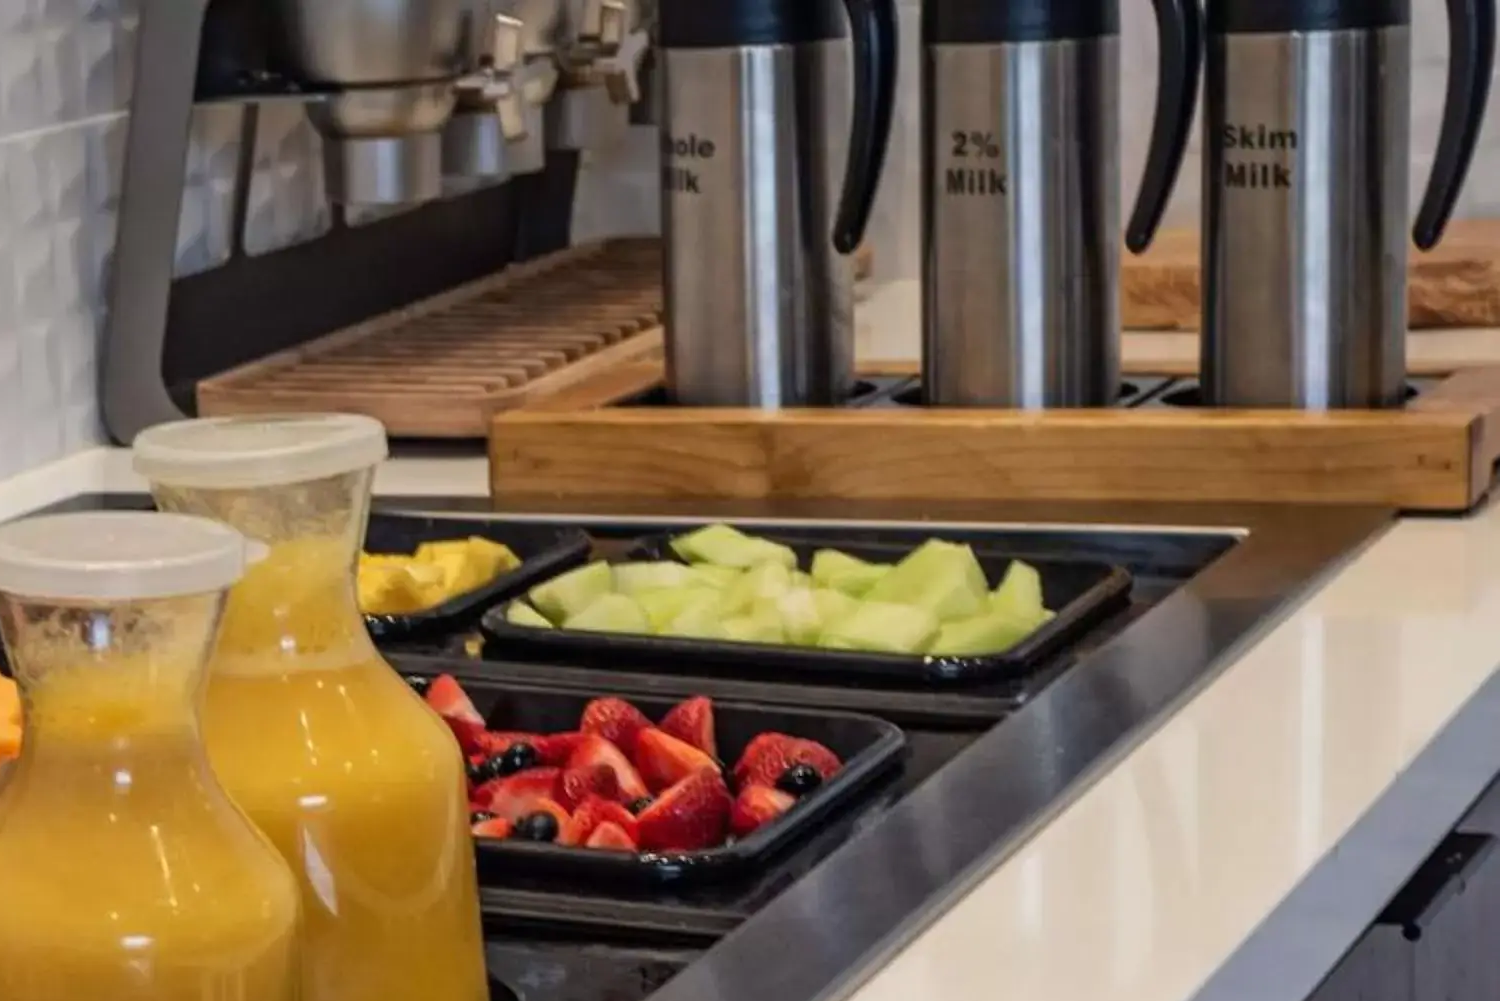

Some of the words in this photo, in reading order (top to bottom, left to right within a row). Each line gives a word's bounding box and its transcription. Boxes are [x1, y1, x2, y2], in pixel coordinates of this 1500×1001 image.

[951, 131, 1000, 158] 2%
[1222, 123, 1298, 149] Skim
[946, 167, 1008, 196] Milk
[1225, 161, 1292, 188] Milk
